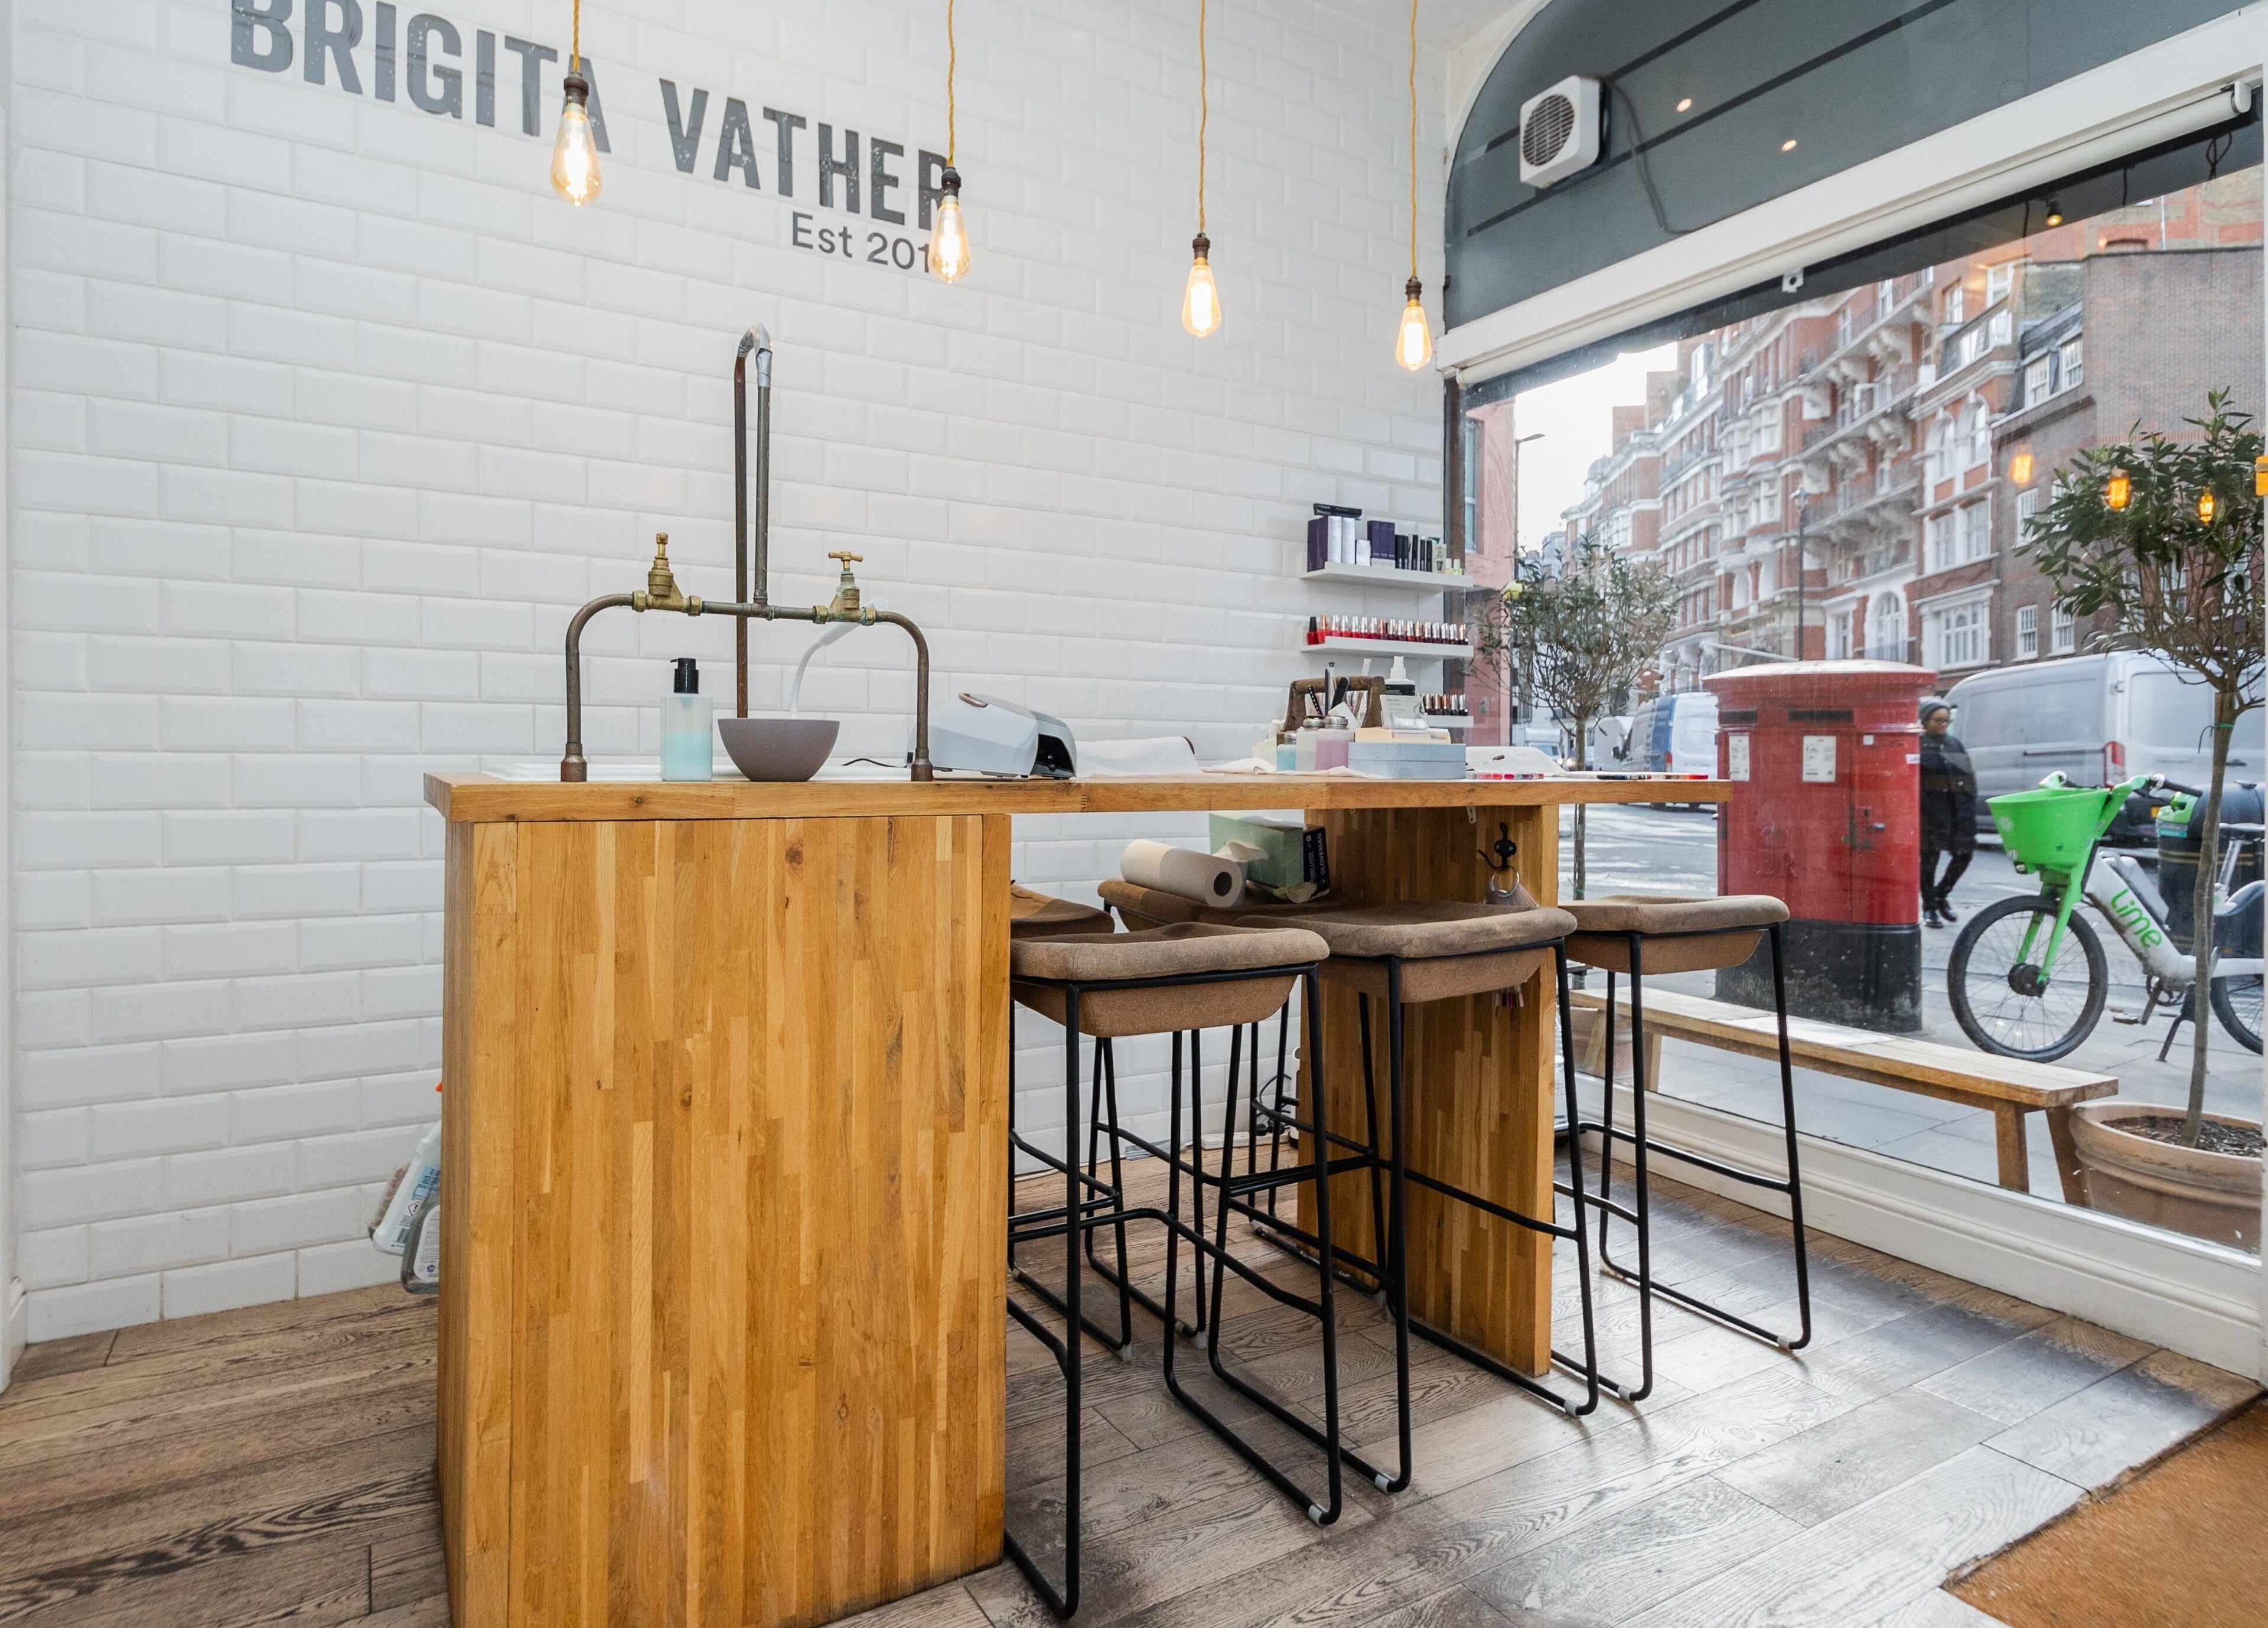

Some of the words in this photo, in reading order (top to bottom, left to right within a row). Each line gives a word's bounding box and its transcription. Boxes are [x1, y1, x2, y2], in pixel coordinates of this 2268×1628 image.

[231, 0, 611, 153] BRIGITA
[793, 211, 852, 258] Est
[866, 232, 930, 273] 201
[1317, 833, 1326, 875] GLOVEMAN
